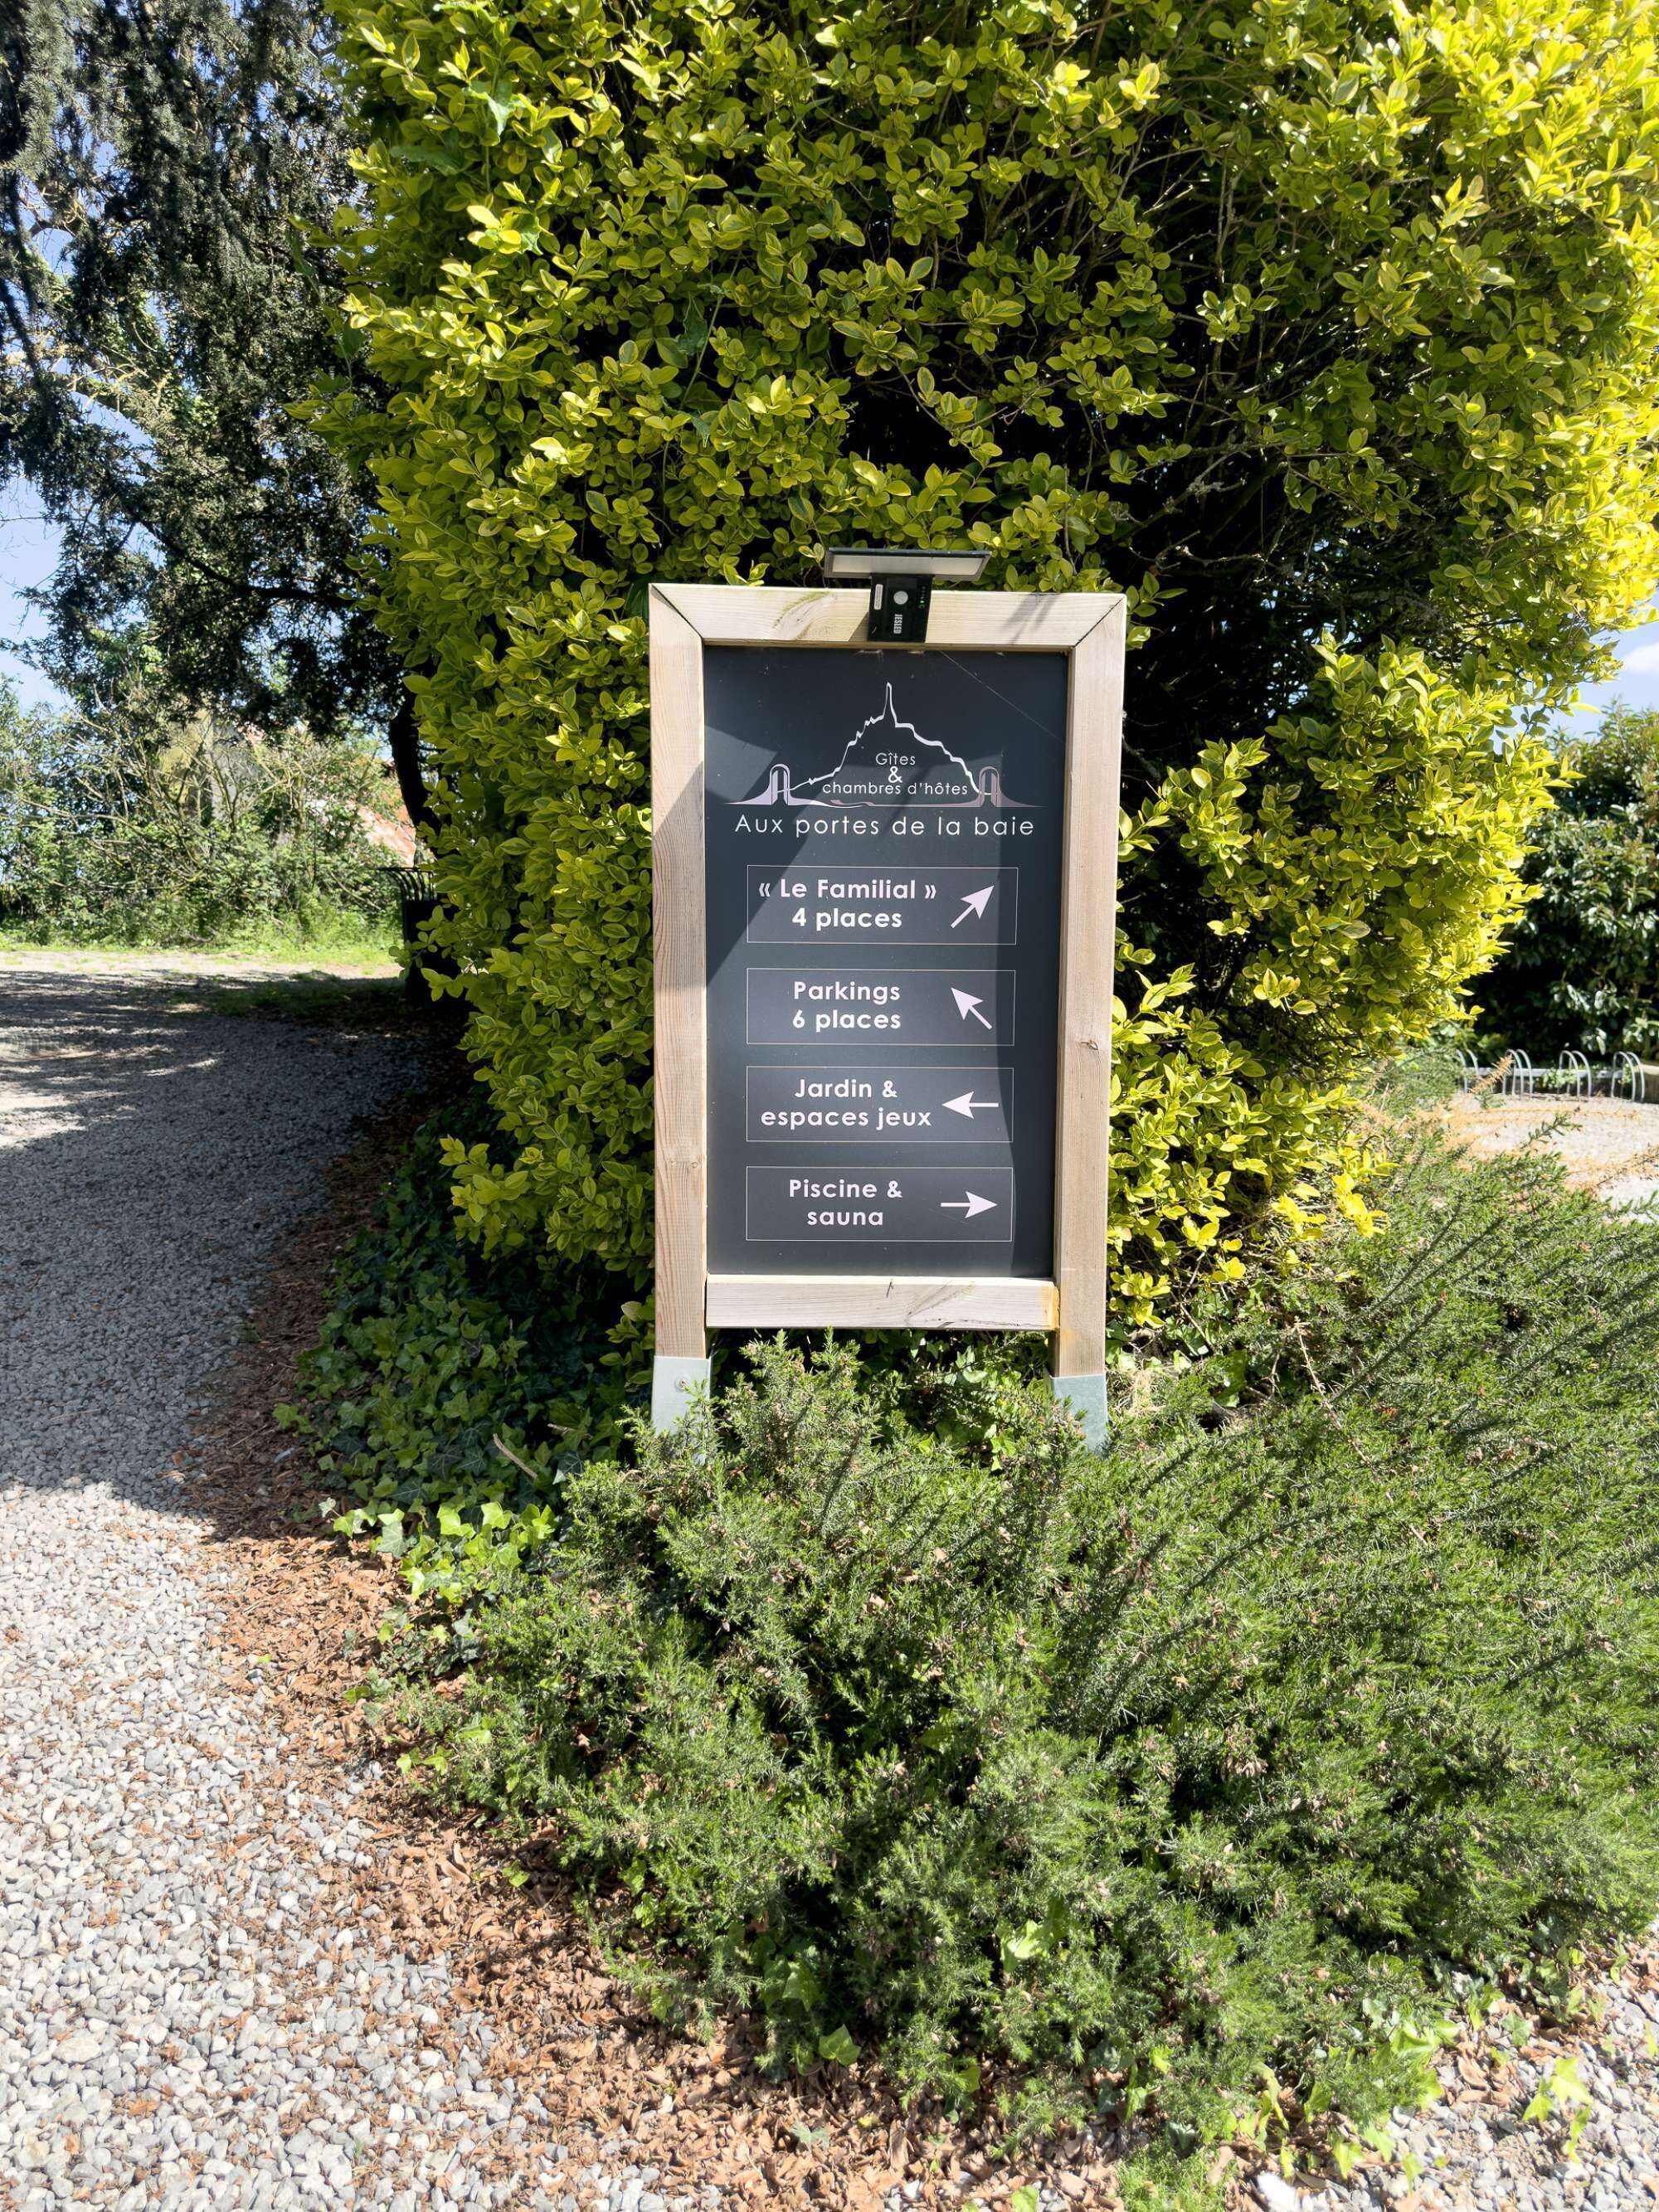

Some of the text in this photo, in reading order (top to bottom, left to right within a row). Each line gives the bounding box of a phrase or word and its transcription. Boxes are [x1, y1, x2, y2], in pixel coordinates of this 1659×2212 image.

[875, 752, 916, 766] Gîtes
[888, 766, 902, 783] &
[822, 781, 968, 795] chambres d'hôtes
[734, 814, 1034, 838] Aux portes de la baie
[780, 878, 808, 898] Le
[817, 879, 916, 899] Familial
[792, 908, 902, 931] 4 places
[793, 981, 901, 1004] Parkings
[792, 1009, 901, 1033] 6 places
[794, 1078, 898, 1098] Jardin &
[761, 1106, 932, 1130] espaces jeux
[789, 1179, 902, 1198] Piscine &
[806, 1209, 883, 1226] sauna
